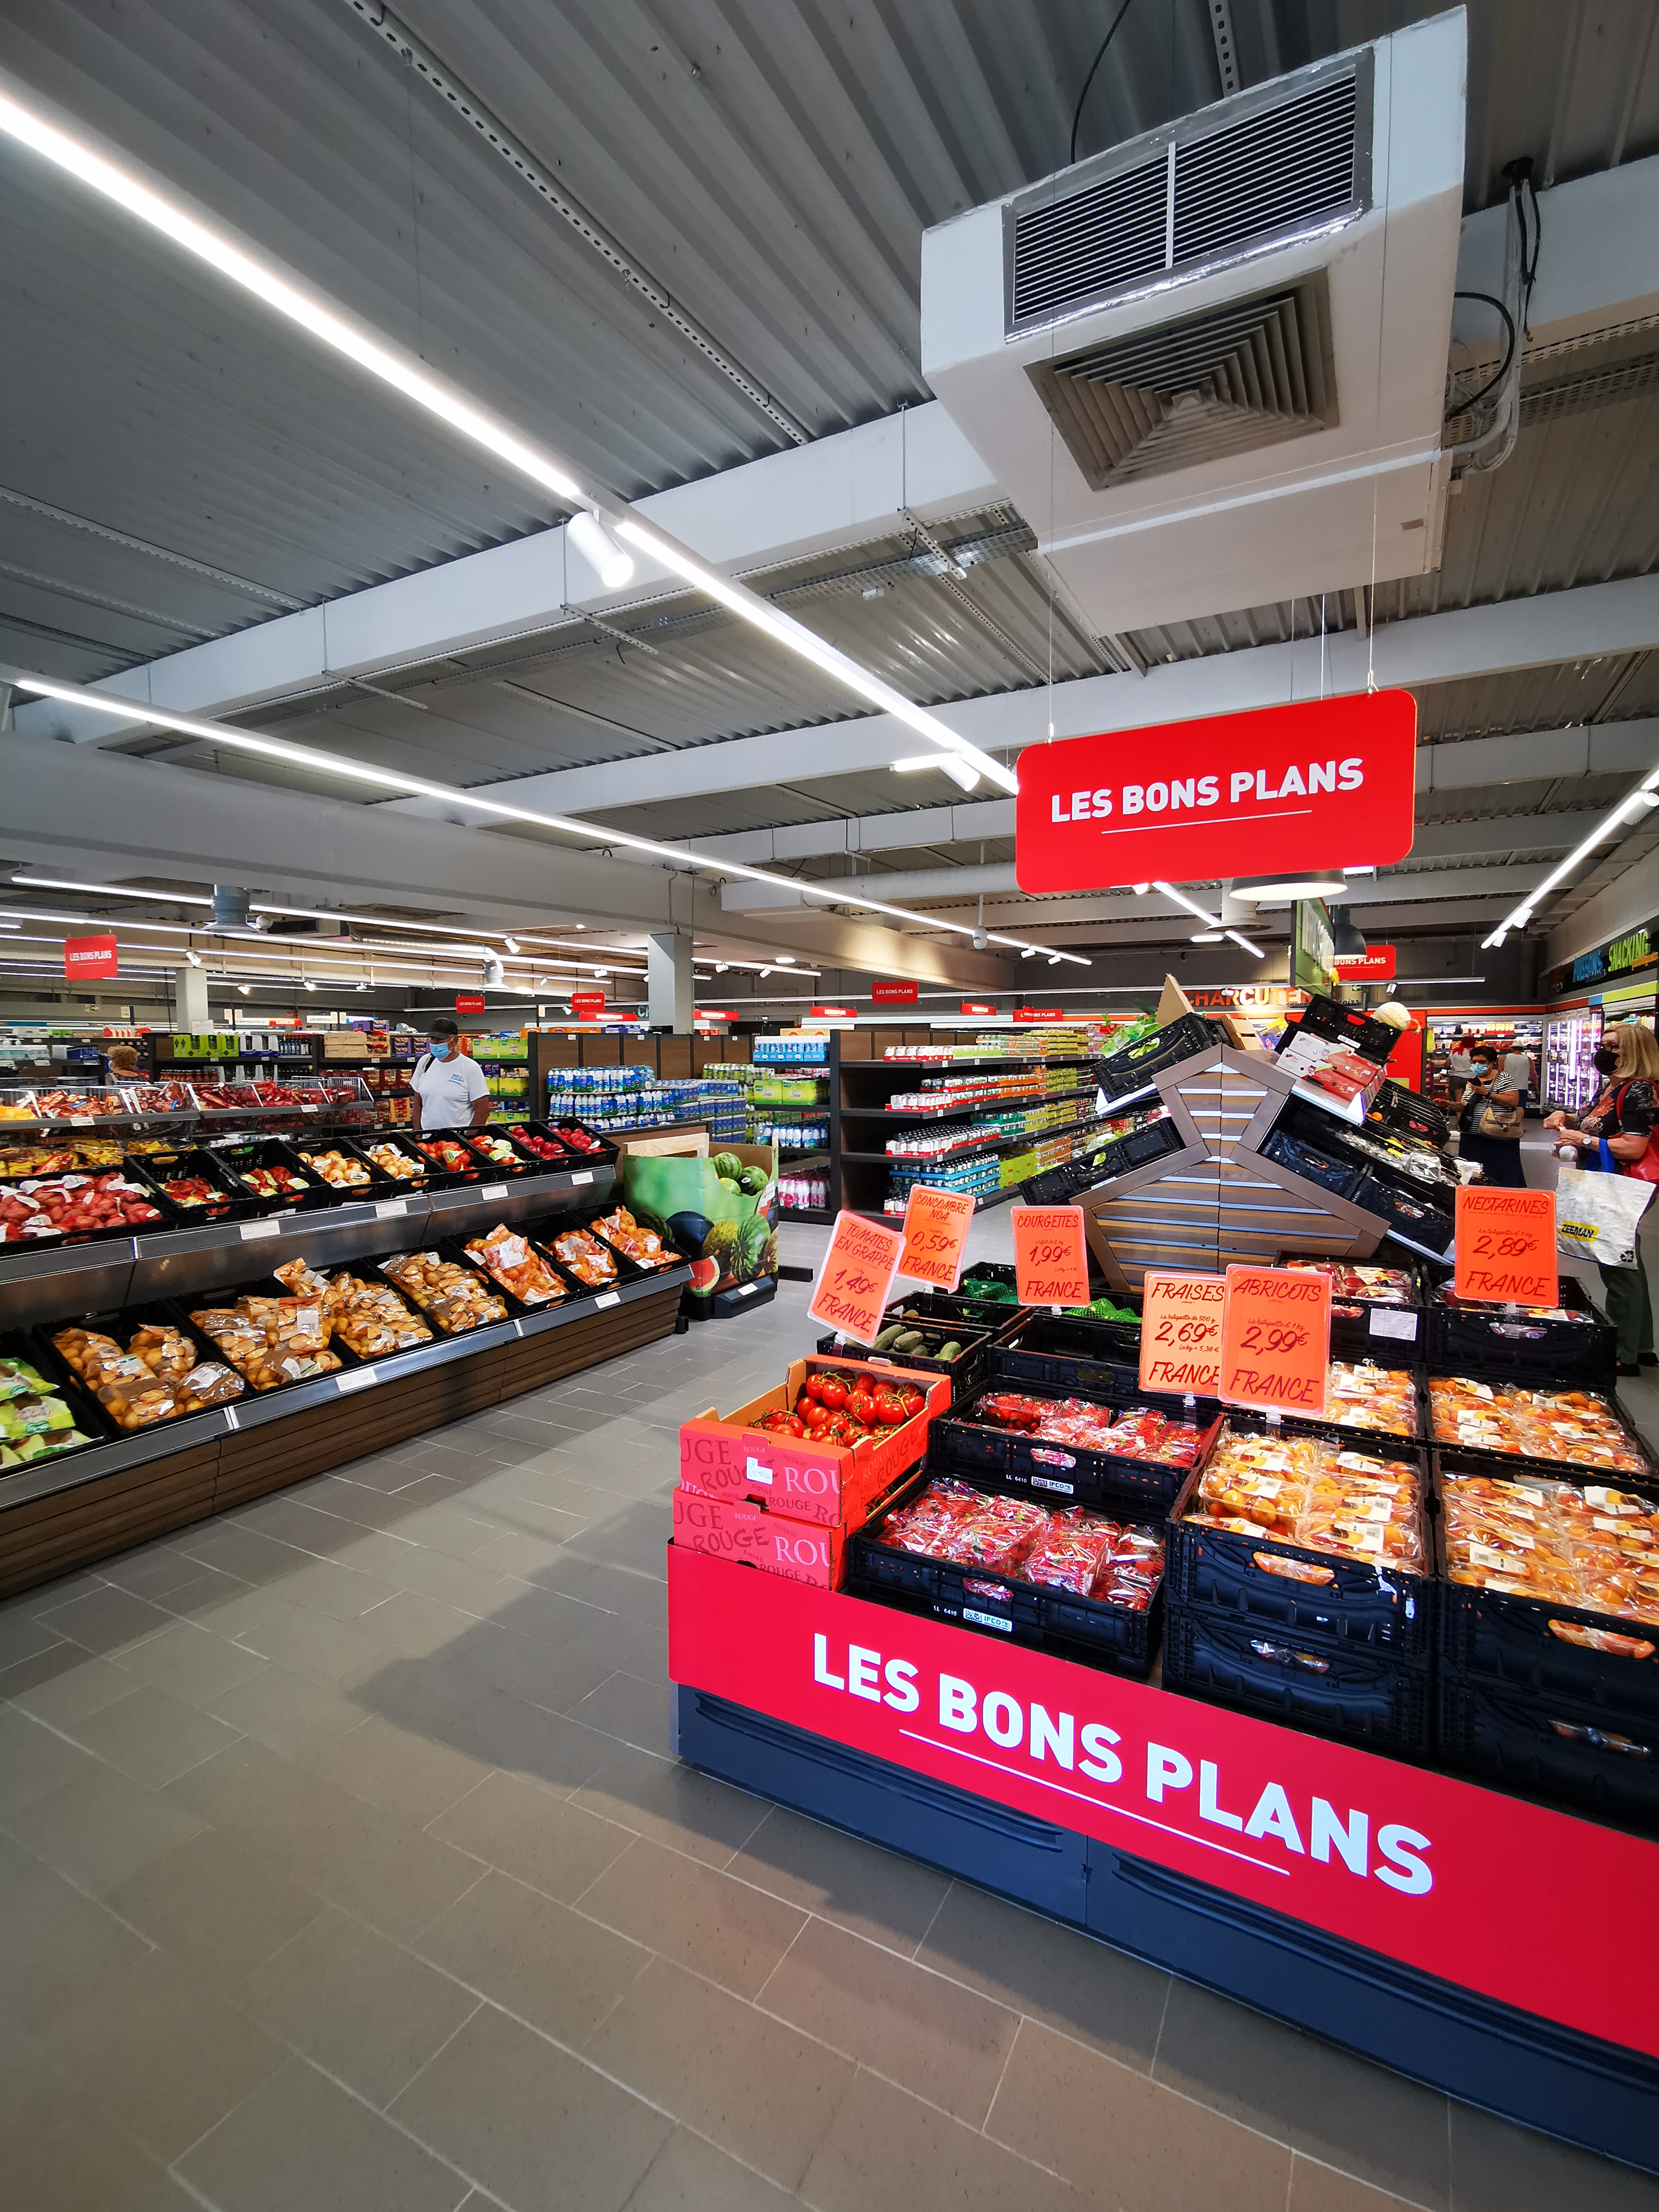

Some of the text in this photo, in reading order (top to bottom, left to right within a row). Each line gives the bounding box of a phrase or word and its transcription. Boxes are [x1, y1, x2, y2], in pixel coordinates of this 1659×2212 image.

[1051, 758, 1364, 823] LES BONS PLANS
[916, 1195, 969, 1214] CONCOMBRE
[929, 1209, 950, 1221] NOA
[1463, 1196, 1549, 1214] NECTARINES
[1017, 1214, 1079, 1228] COURGETTES
[1561, 1224, 1595, 1238] ZEEMAN
[846, 1223, 893, 1252] TOMATES
[911, 1231, 958, 1252] 0,59€
[1472, 1235, 1540, 1260] 2,89€
[835, 1236, 853, 1251] EN
[852, 1243, 895, 1271] GRAPPE
[1029, 1246, 1072, 1266] 1,99€
[902, 1255, 957, 1281] FRANCE
[834, 1269, 878, 1294] 1,49€
[1025, 1280, 1084, 1299] FRANCE
[1151, 1282, 1224, 1303] FRAISES
[1233, 1278, 1322, 1302] ABRICOTS
[1465, 1270, 1551, 1297] FRANCE
[817, 1292, 877, 1333] FRANCE
[1154, 1321, 1220, 1347] 2,69€
[1240, 1326, 1310, 1356] 2,99€
[1148, 1360, 1220, 1386] FRANCE
[1229, 1369, 1320, 1404] FRANCE
[877, 1423, 918, 1489] ROUGE
[1049, 1481, 1065, 1489] IFCO
[769, 1496, 811, 1511] ROUGE
[693, 1526, 770, 1553] ROUGE
[759, 1563, 801, 1581] ROUGE
[944, 1608, 957, 1617] 6410
[984, 1615, 1001, 1625] IFCO
[813, 1633, 1434, 1895] LES BONS PLANS
